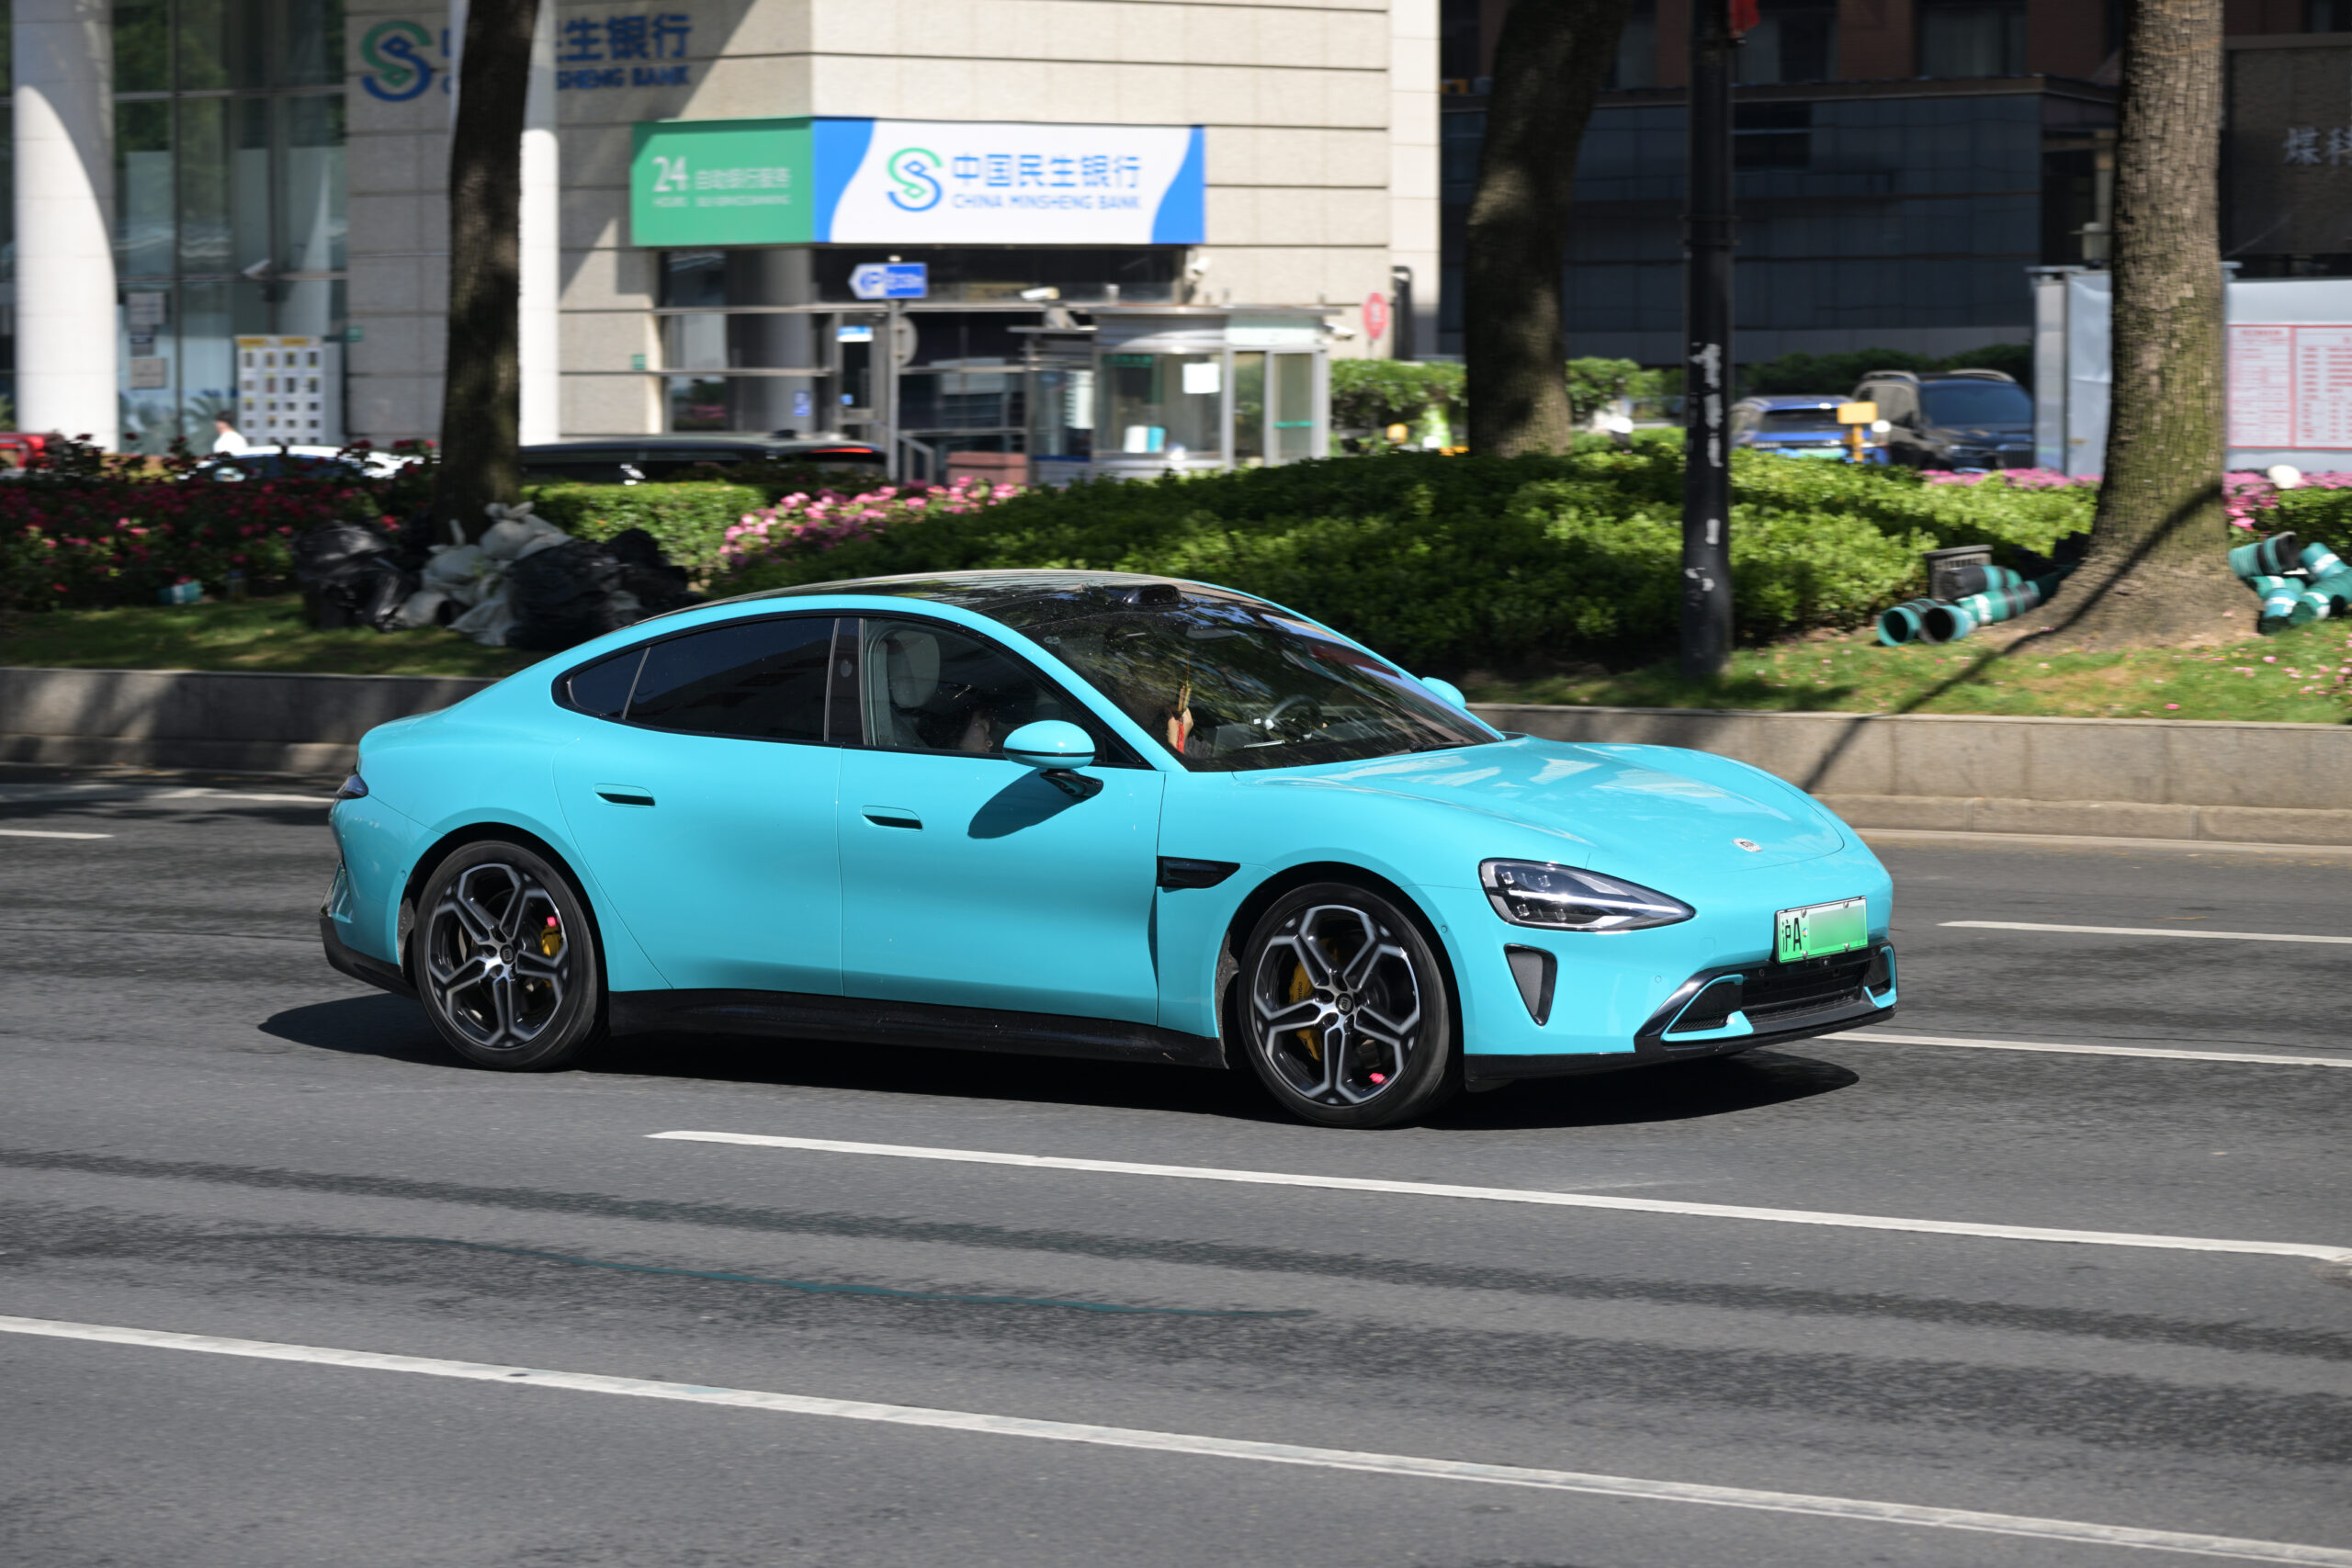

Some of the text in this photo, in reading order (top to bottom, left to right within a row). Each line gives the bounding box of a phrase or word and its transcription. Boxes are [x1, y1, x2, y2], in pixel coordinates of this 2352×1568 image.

[631, 65, 689, 87] BANK
[652, 156, 688, 193] 24
[953, 152, 1141, 188] 中国民生银行
[953, 193, 1140, 210] CHINA MINSHENG BANK
[1781, 917, 1802, 953] 沪A
